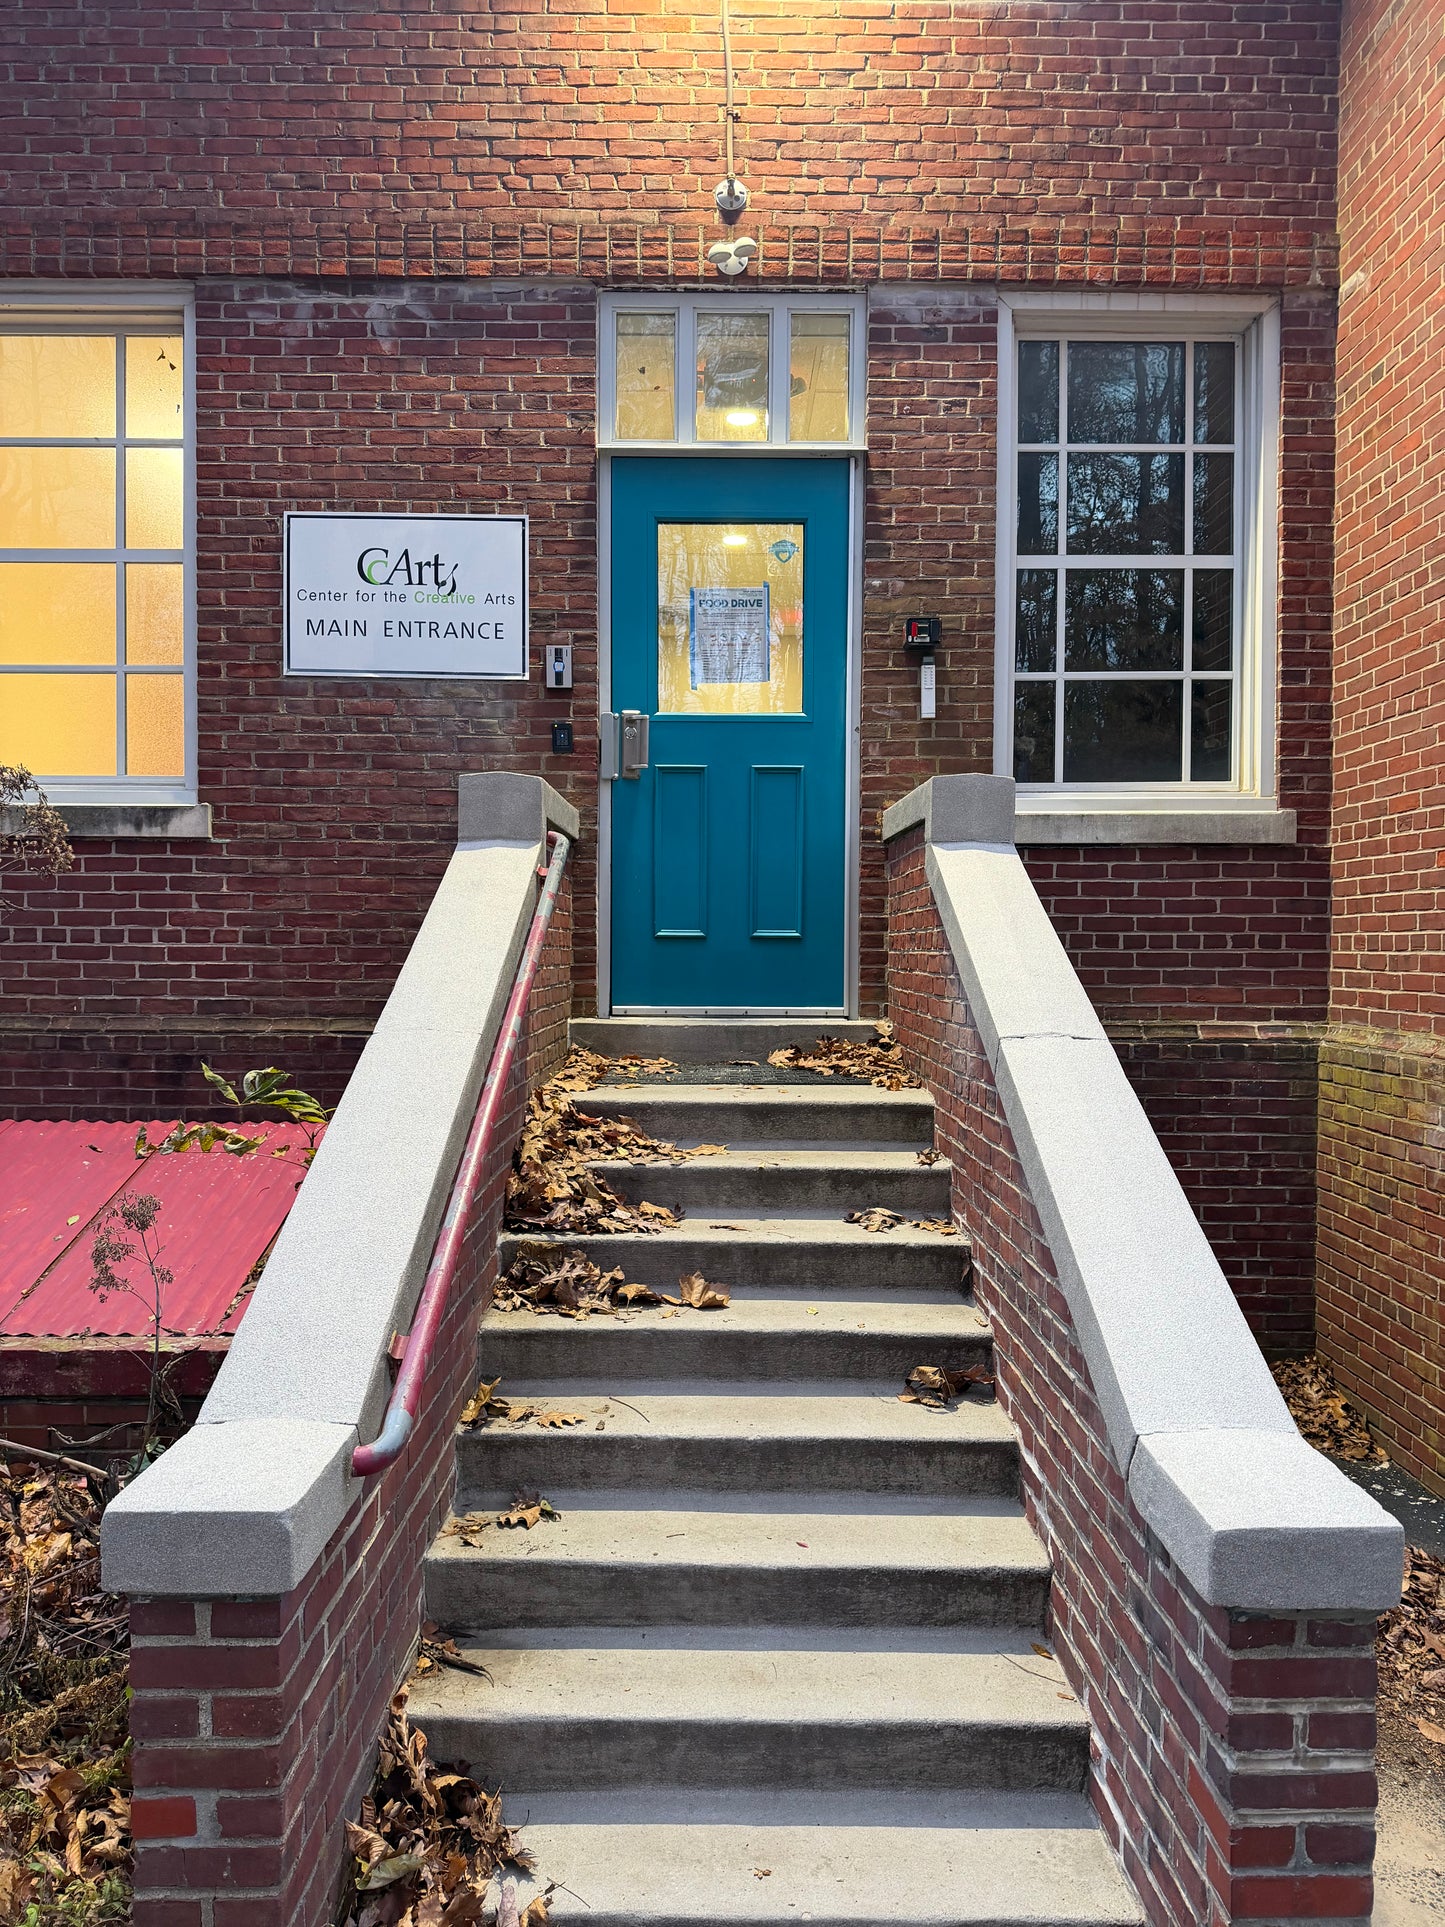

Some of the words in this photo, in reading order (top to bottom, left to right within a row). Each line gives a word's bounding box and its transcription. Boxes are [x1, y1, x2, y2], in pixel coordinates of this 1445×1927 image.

[296, 588, 347, 602] Center
[356, 589, 376, 603] for
[384, 590, 407, 603] the
[414, 590, 475, 604] Creative
[484, 592, 516, 605] Arts
[699, 599, 728, 608] FOOD
[731, 599, 763, 608] DRIVE
[306, 619, 367, 637] MAIN
[384, 620, 504, 640] ENTRANCE
